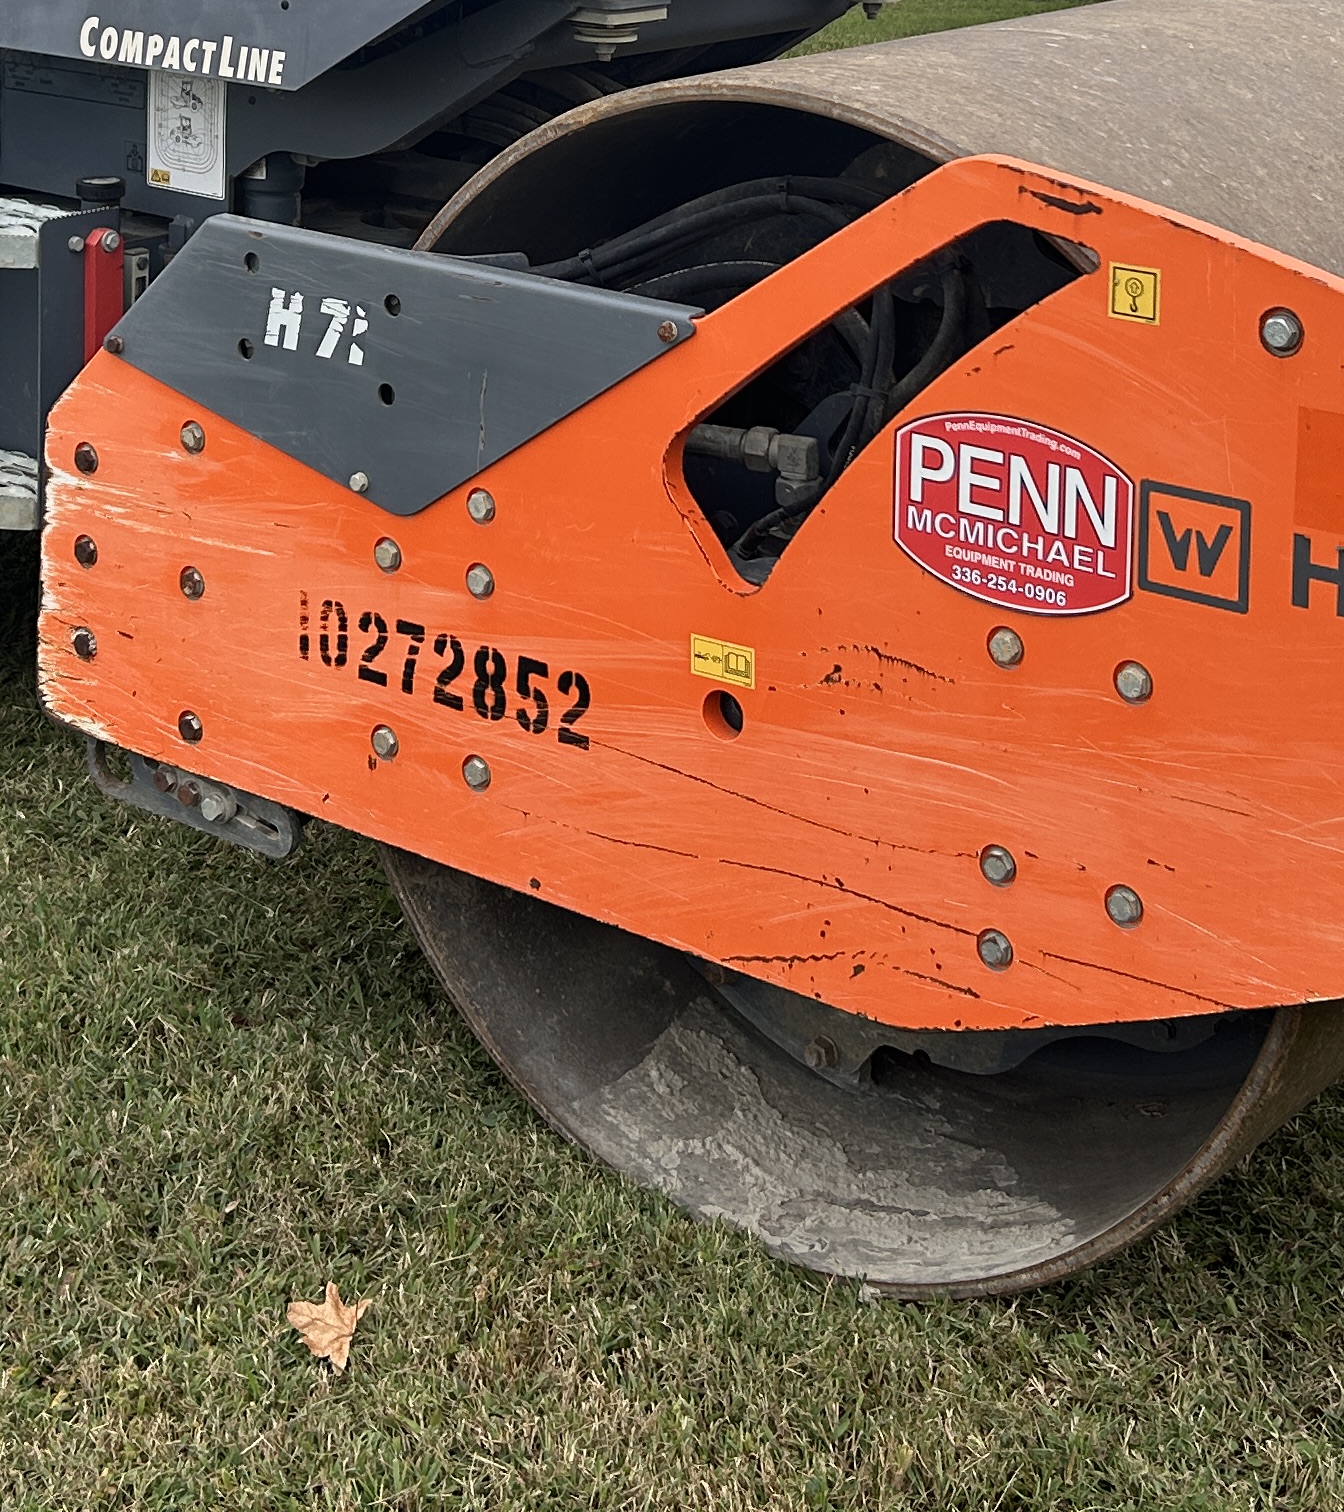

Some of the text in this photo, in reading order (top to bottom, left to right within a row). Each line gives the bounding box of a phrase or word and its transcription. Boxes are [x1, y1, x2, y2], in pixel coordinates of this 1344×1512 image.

[264, 287, 304, 351] H
[944, 420, 1082, 460] PennEquipmentTrading.com
[910, 432, 1119, 549] PENN
[906, 505, 1117, 579] MCMICHAEL
[944, 544, 1075, 588] EQUIPMENT TRADING
[951, 564, 1067, 607] 336-254-0906
[299, 589, 591, 750] 10272852
